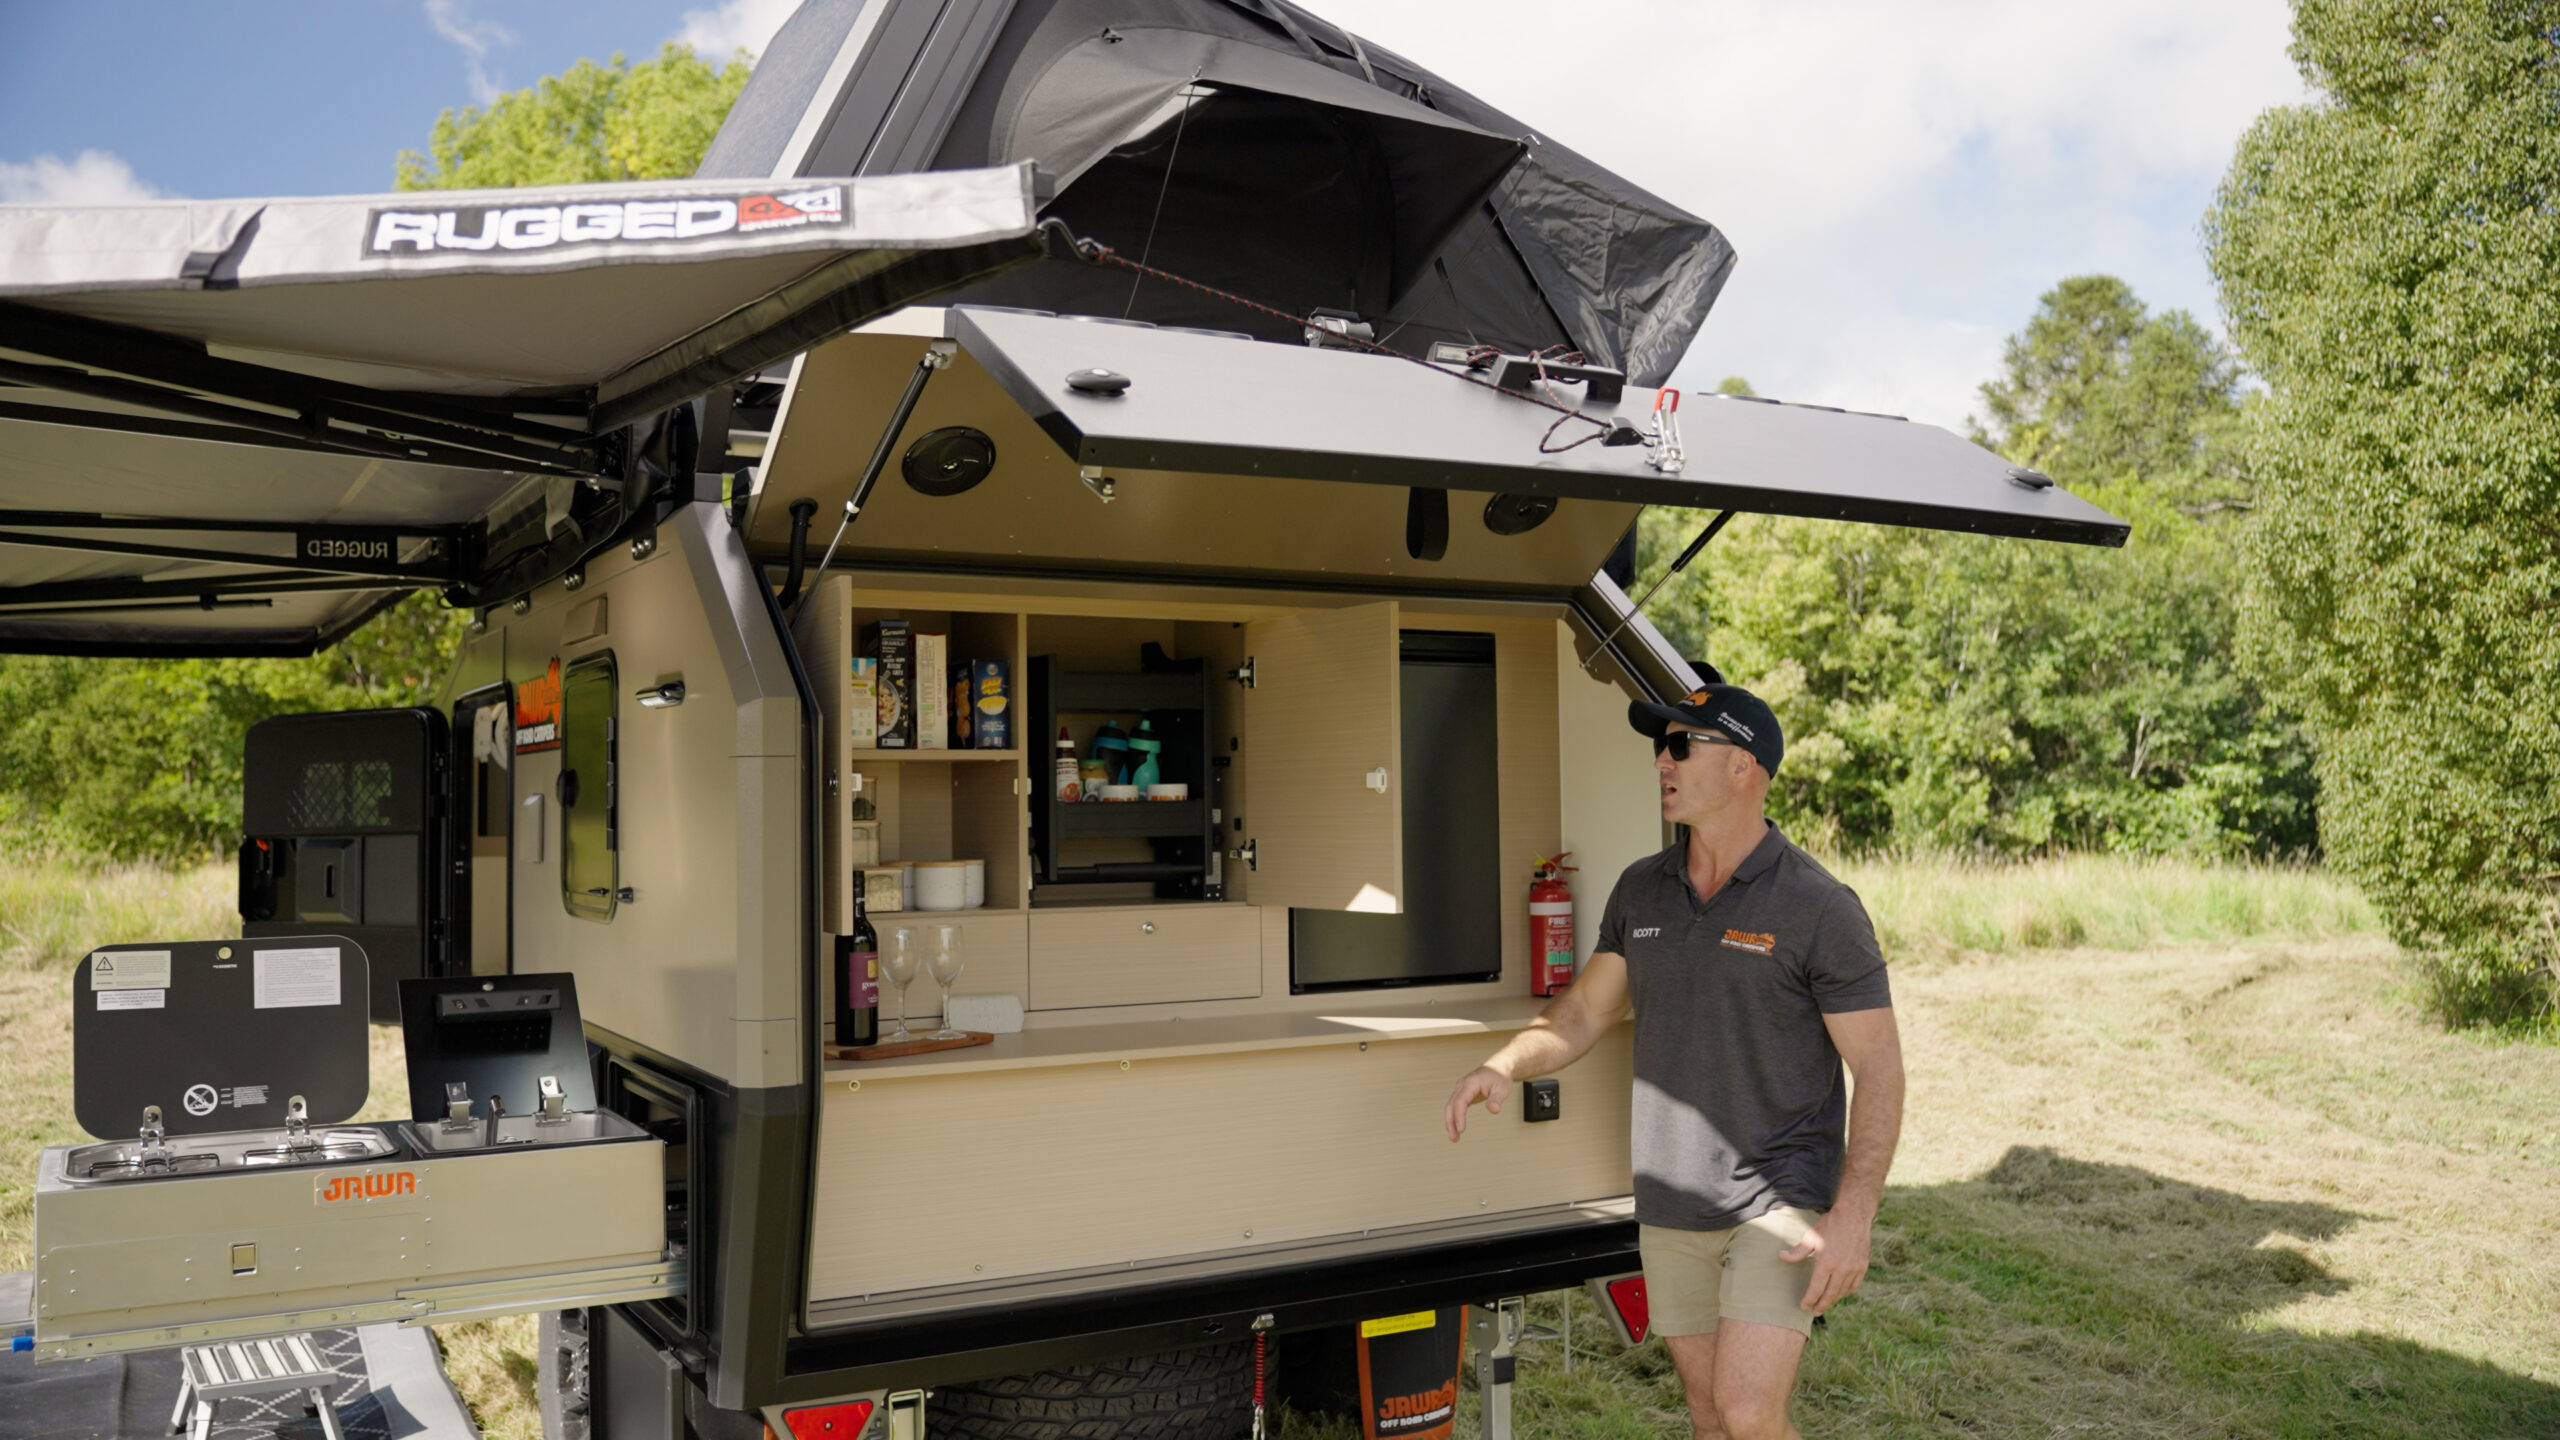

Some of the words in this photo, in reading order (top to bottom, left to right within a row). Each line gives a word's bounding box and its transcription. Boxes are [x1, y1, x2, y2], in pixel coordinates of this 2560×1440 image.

[372, 200, 737, 251] RUGGED
[1633, 928, 1660, 938] SCOTT
[323, 1171, 416, 1202] JAWA
[1379, 1389, 1442, 1419] JAWA
[1380, 1419, 1399, 1428] OFF
[1400, 1415, 1423, 1426] ROAD
